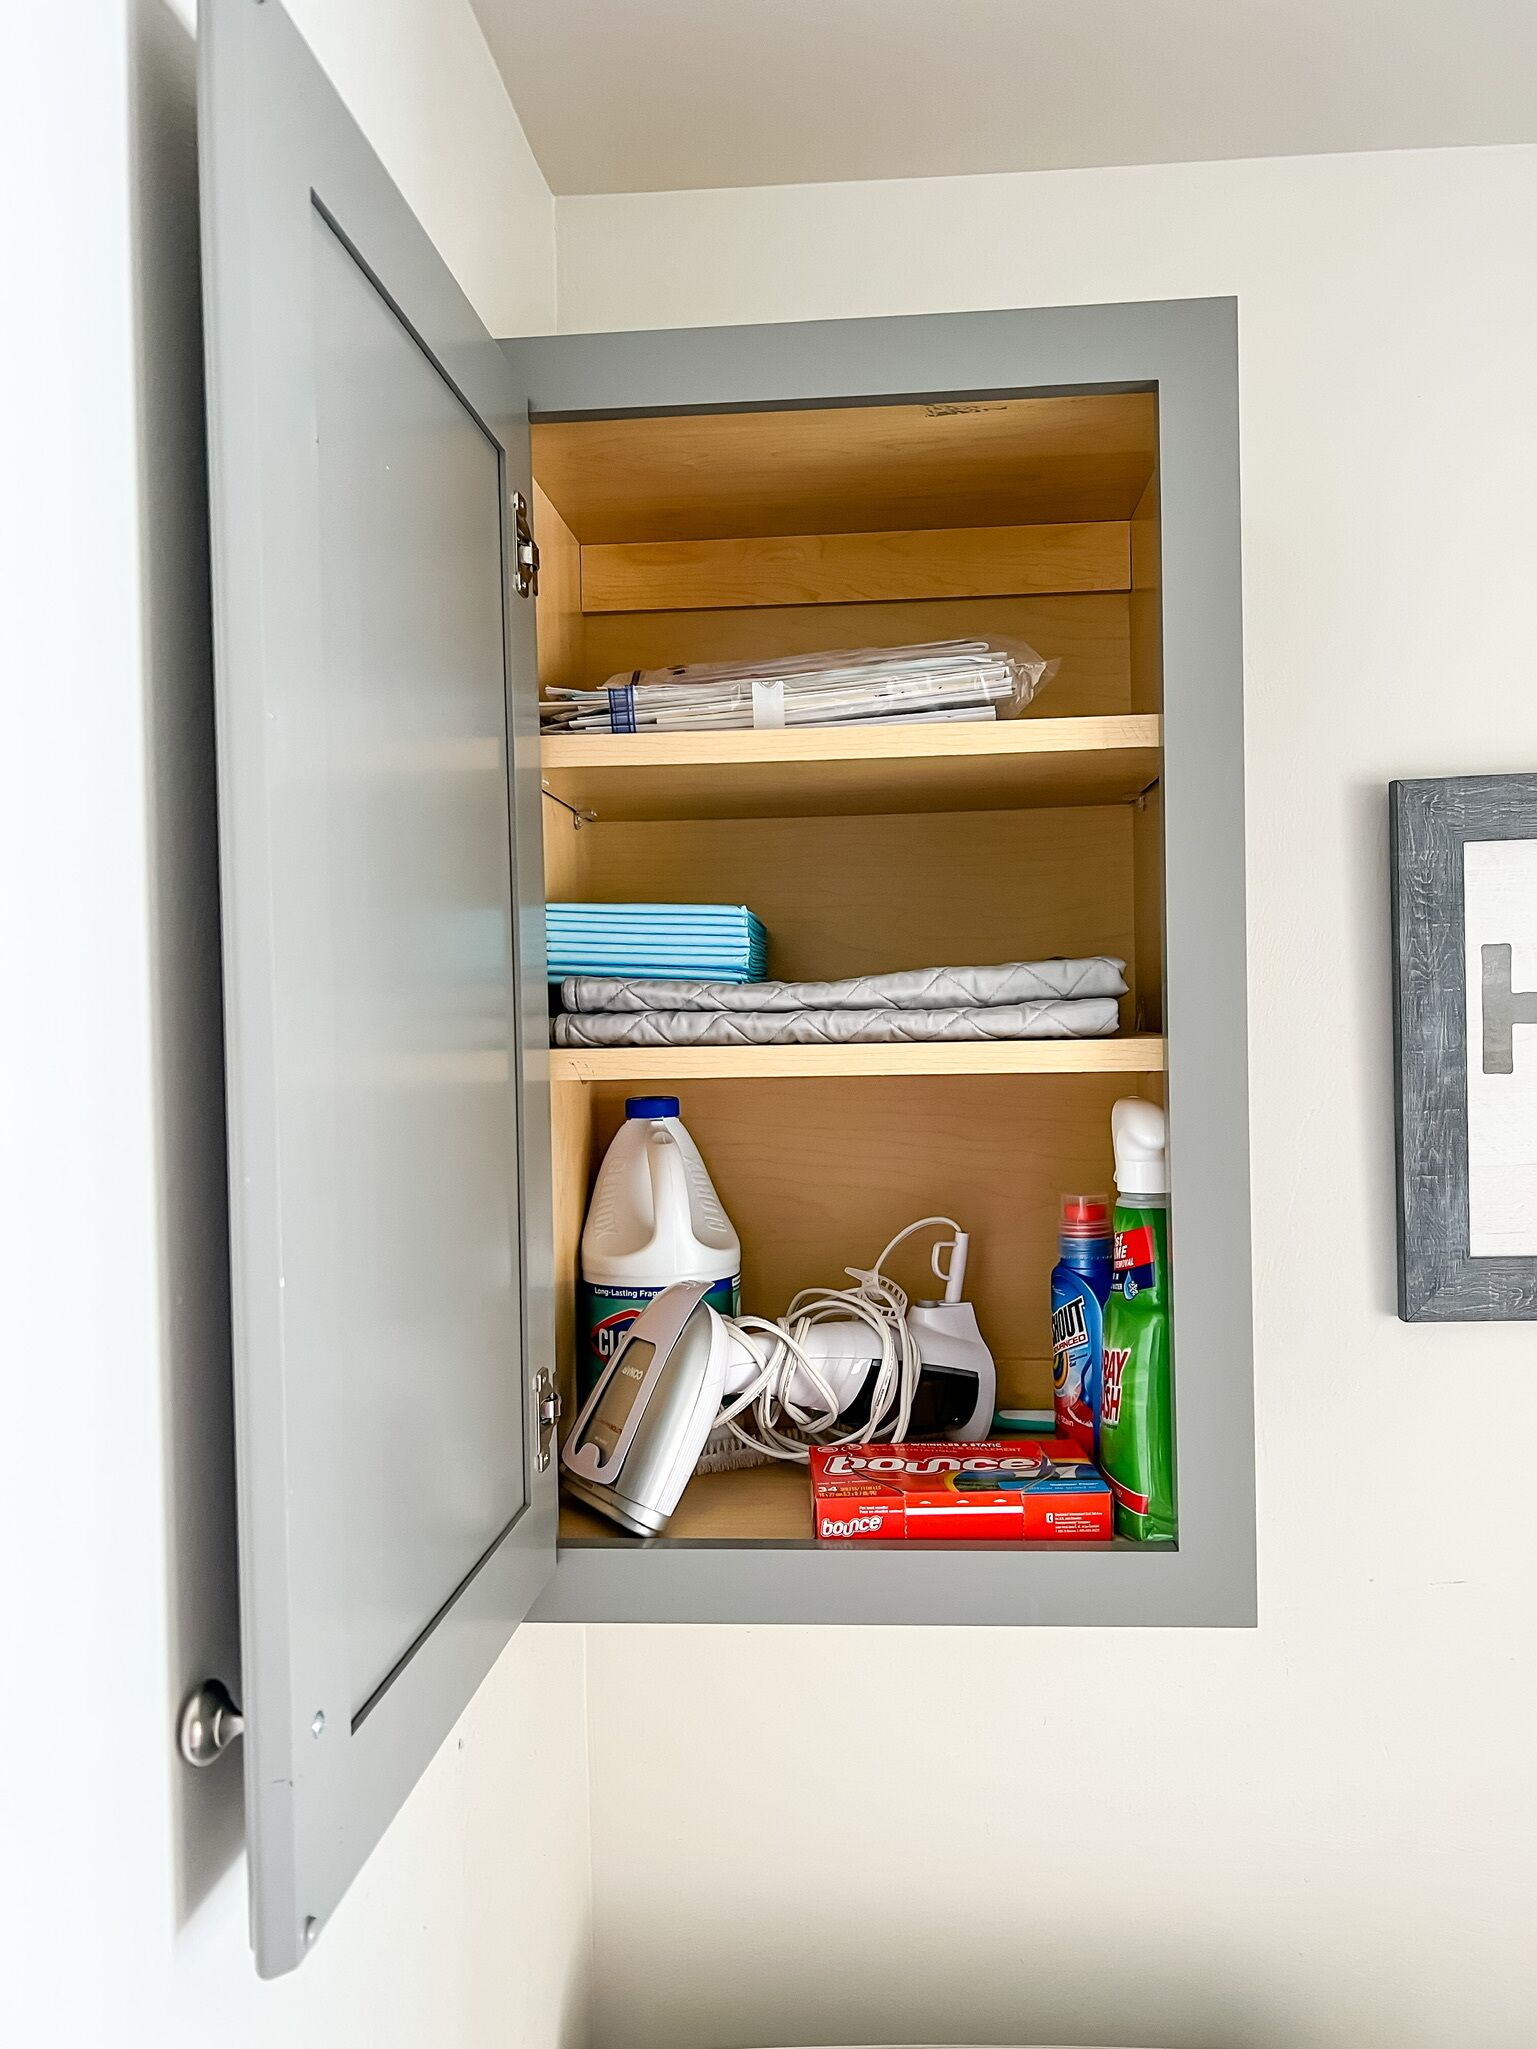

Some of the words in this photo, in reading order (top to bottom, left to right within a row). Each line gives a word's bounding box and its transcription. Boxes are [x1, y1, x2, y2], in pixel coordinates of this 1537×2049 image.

[594, 1287, 638, 1299] Long-Lasting
[639, 1289, 661, 1298] Frag
[1052, 1297, 1084, 1347] HOUT
[1103, 1349, 1129, 1386] RAY
[824, 1455, 1042, 1476] bounce
[821, 1515, 883, 1537] bounce
